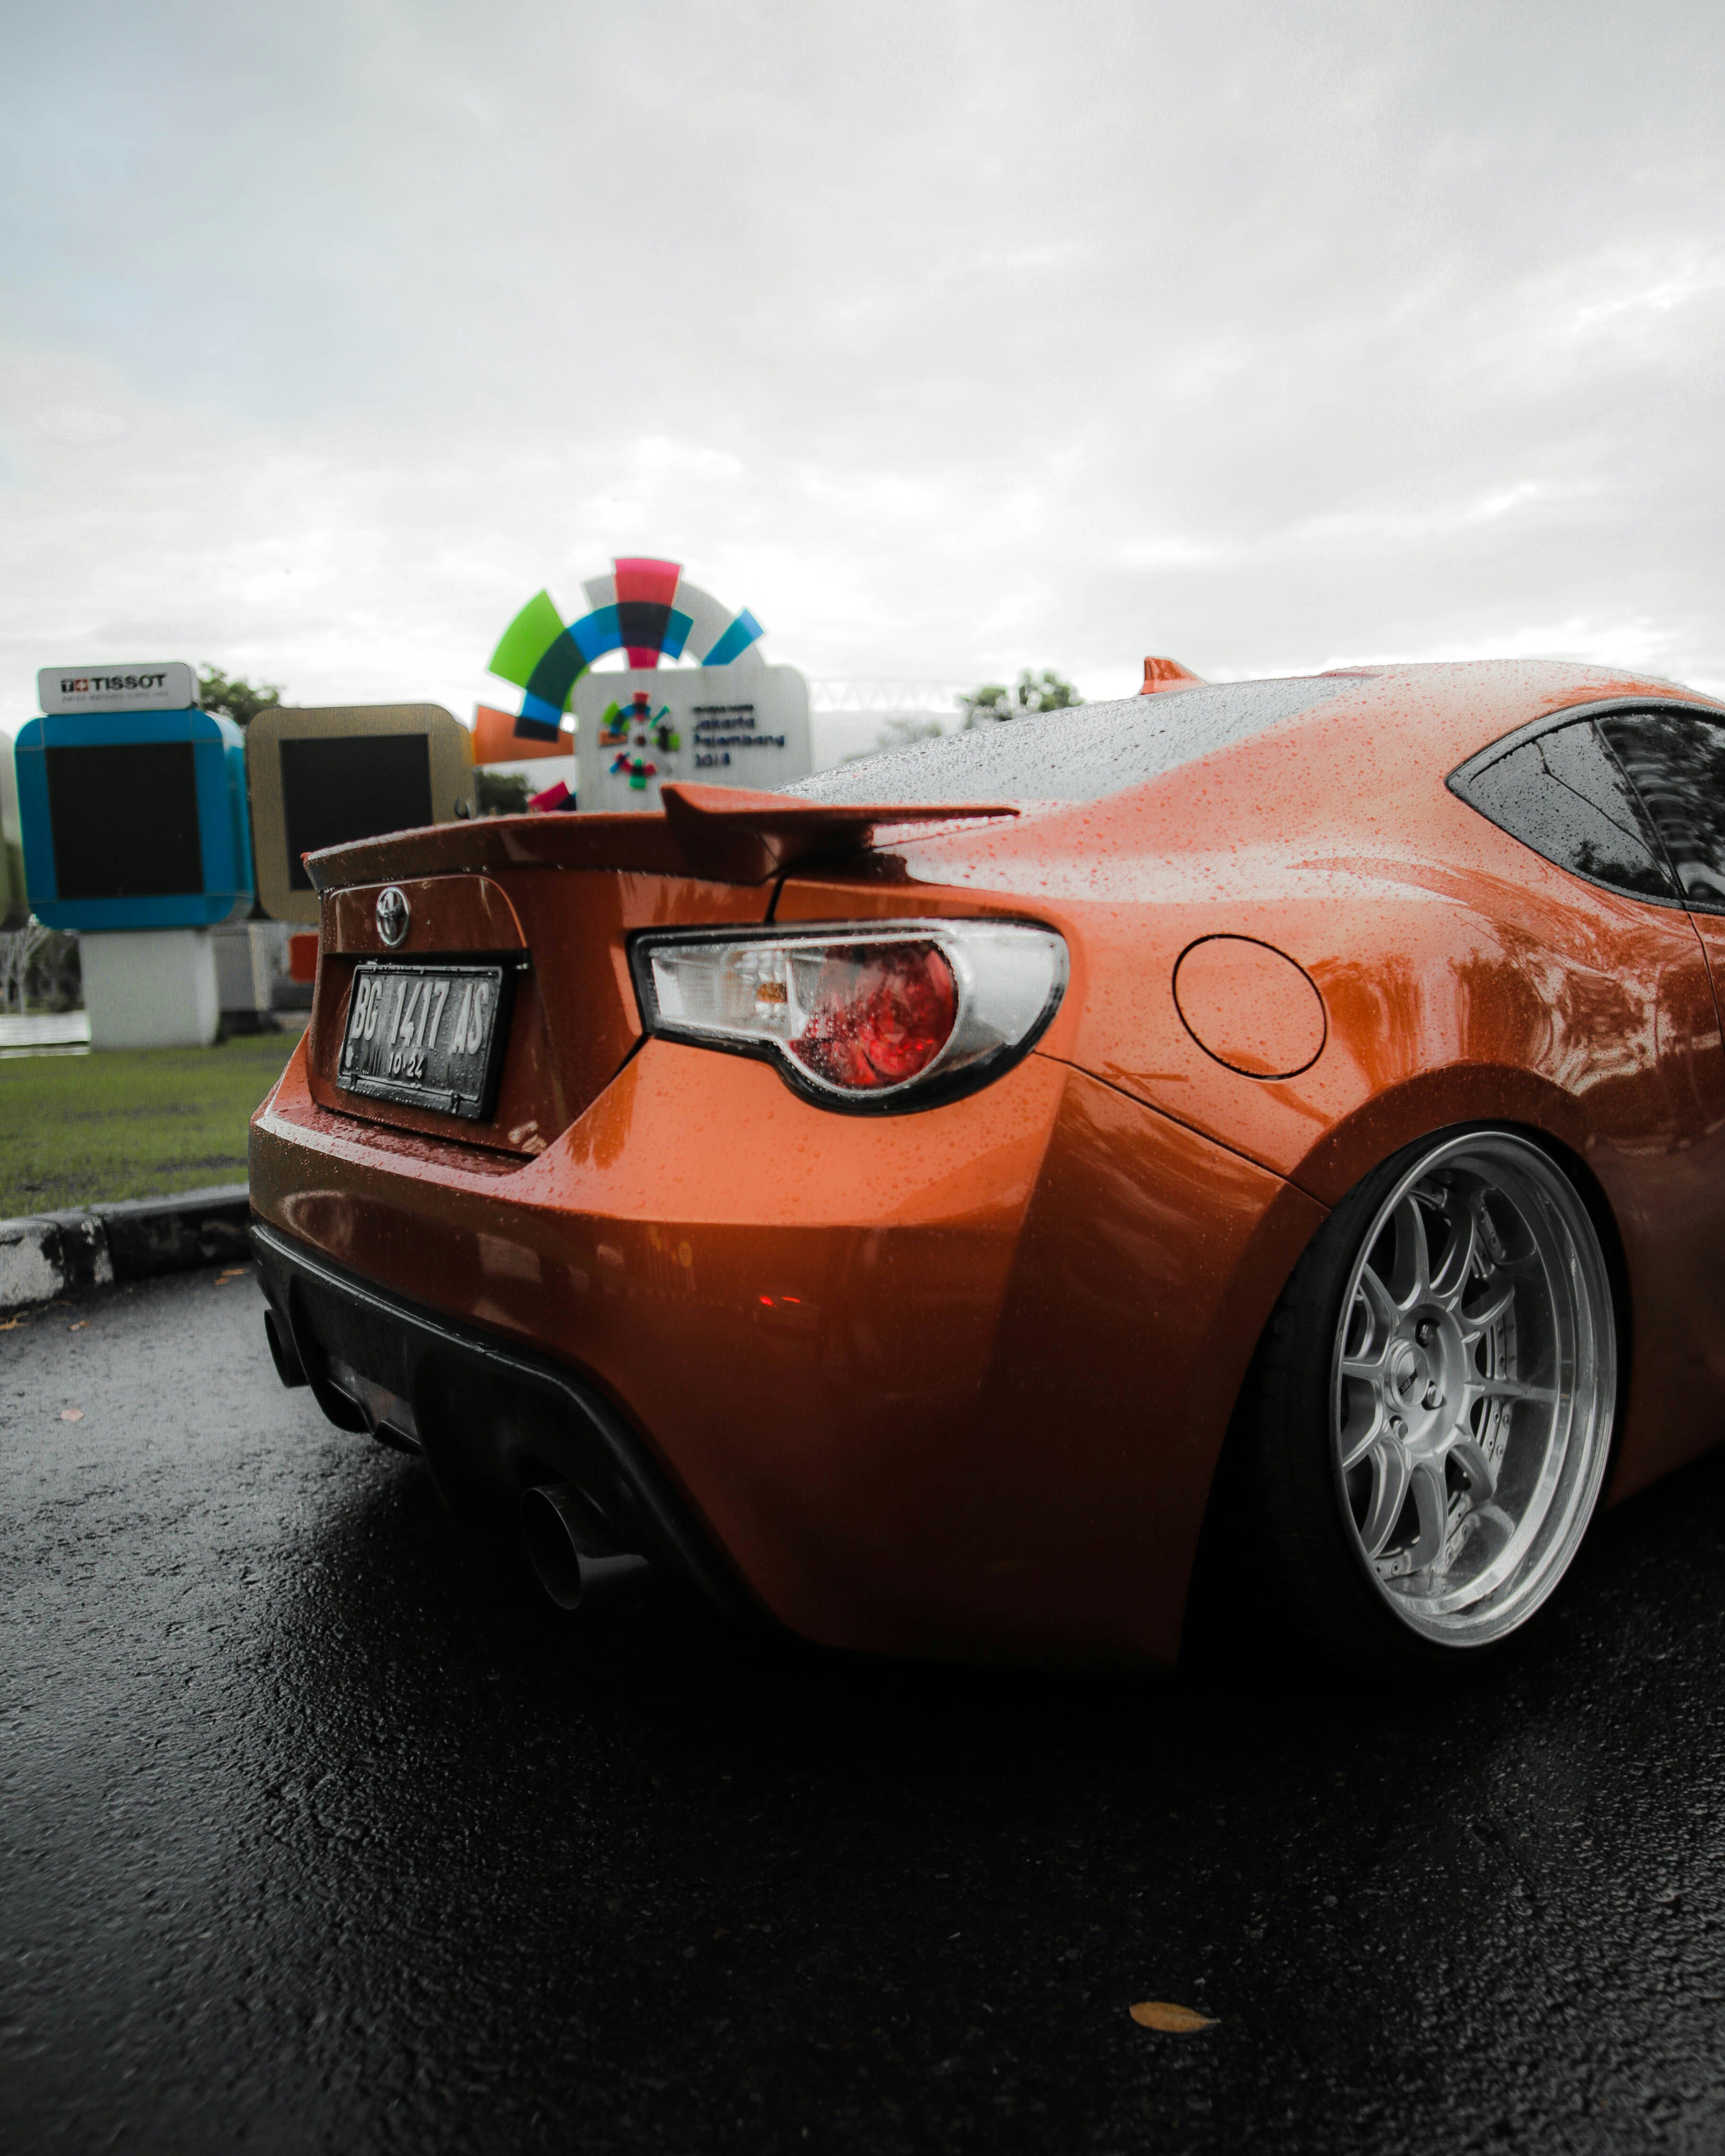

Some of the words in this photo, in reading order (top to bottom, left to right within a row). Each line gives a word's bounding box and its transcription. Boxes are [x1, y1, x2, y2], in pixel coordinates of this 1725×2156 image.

[90, 673, 167, 692] TISSOT
[351, 978, 383, 1041] BG
[390, 980, 450, 1050] 1417
[451, 981, 489, 1055] AS
